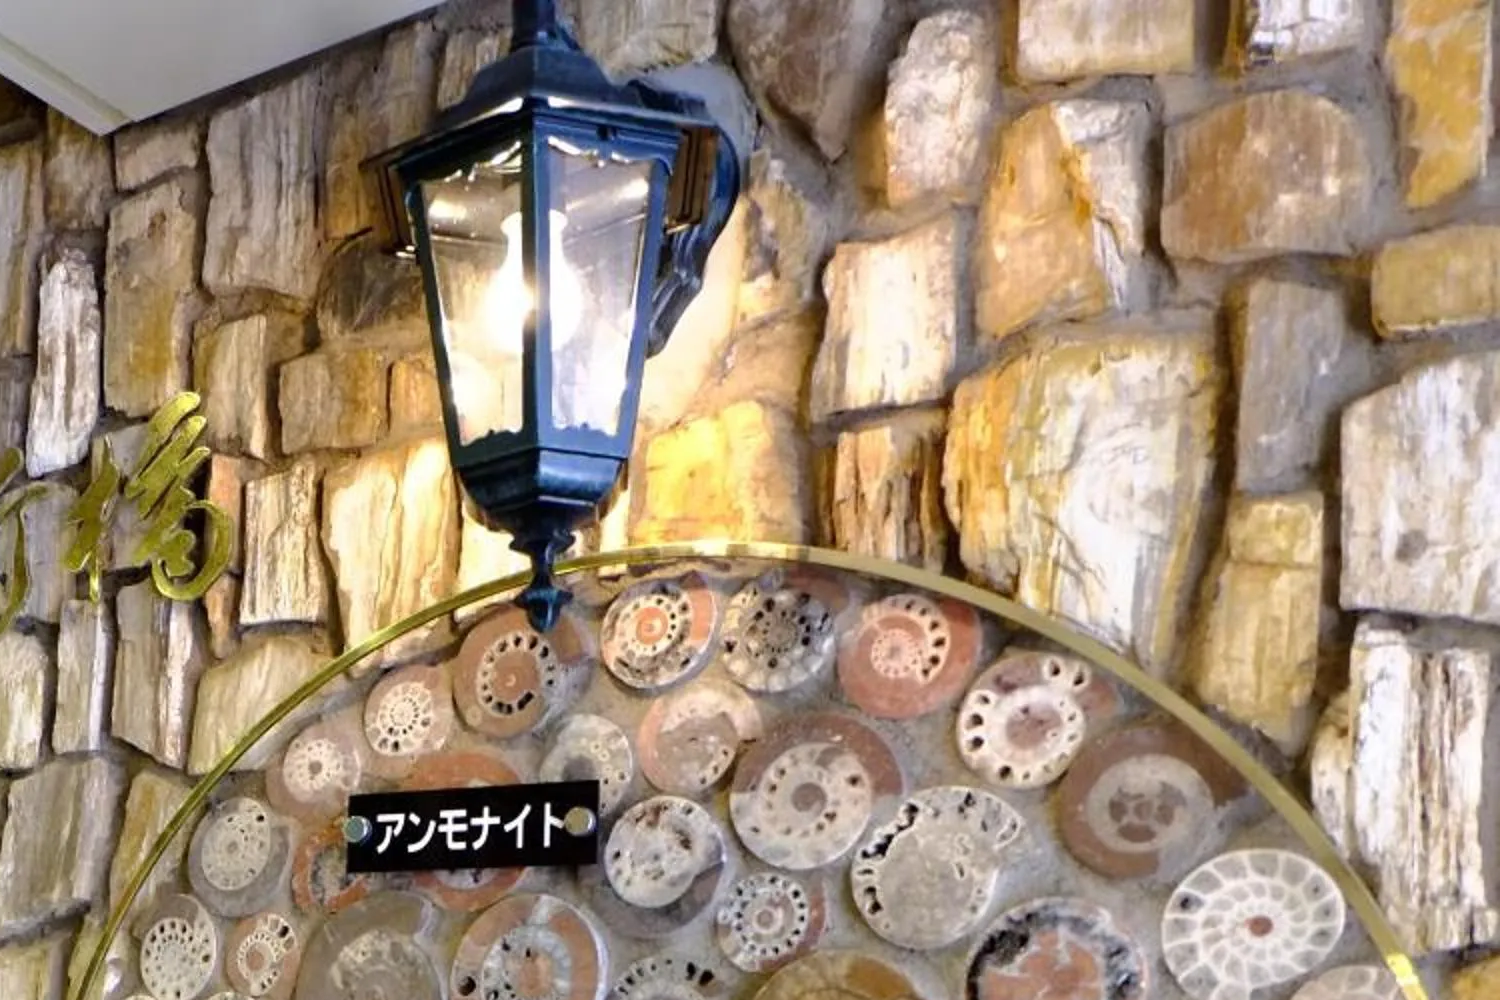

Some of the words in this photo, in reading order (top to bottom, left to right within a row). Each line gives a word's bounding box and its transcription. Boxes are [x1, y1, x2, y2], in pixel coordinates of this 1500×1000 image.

[376, 802, 565, 854] アンモナイト
